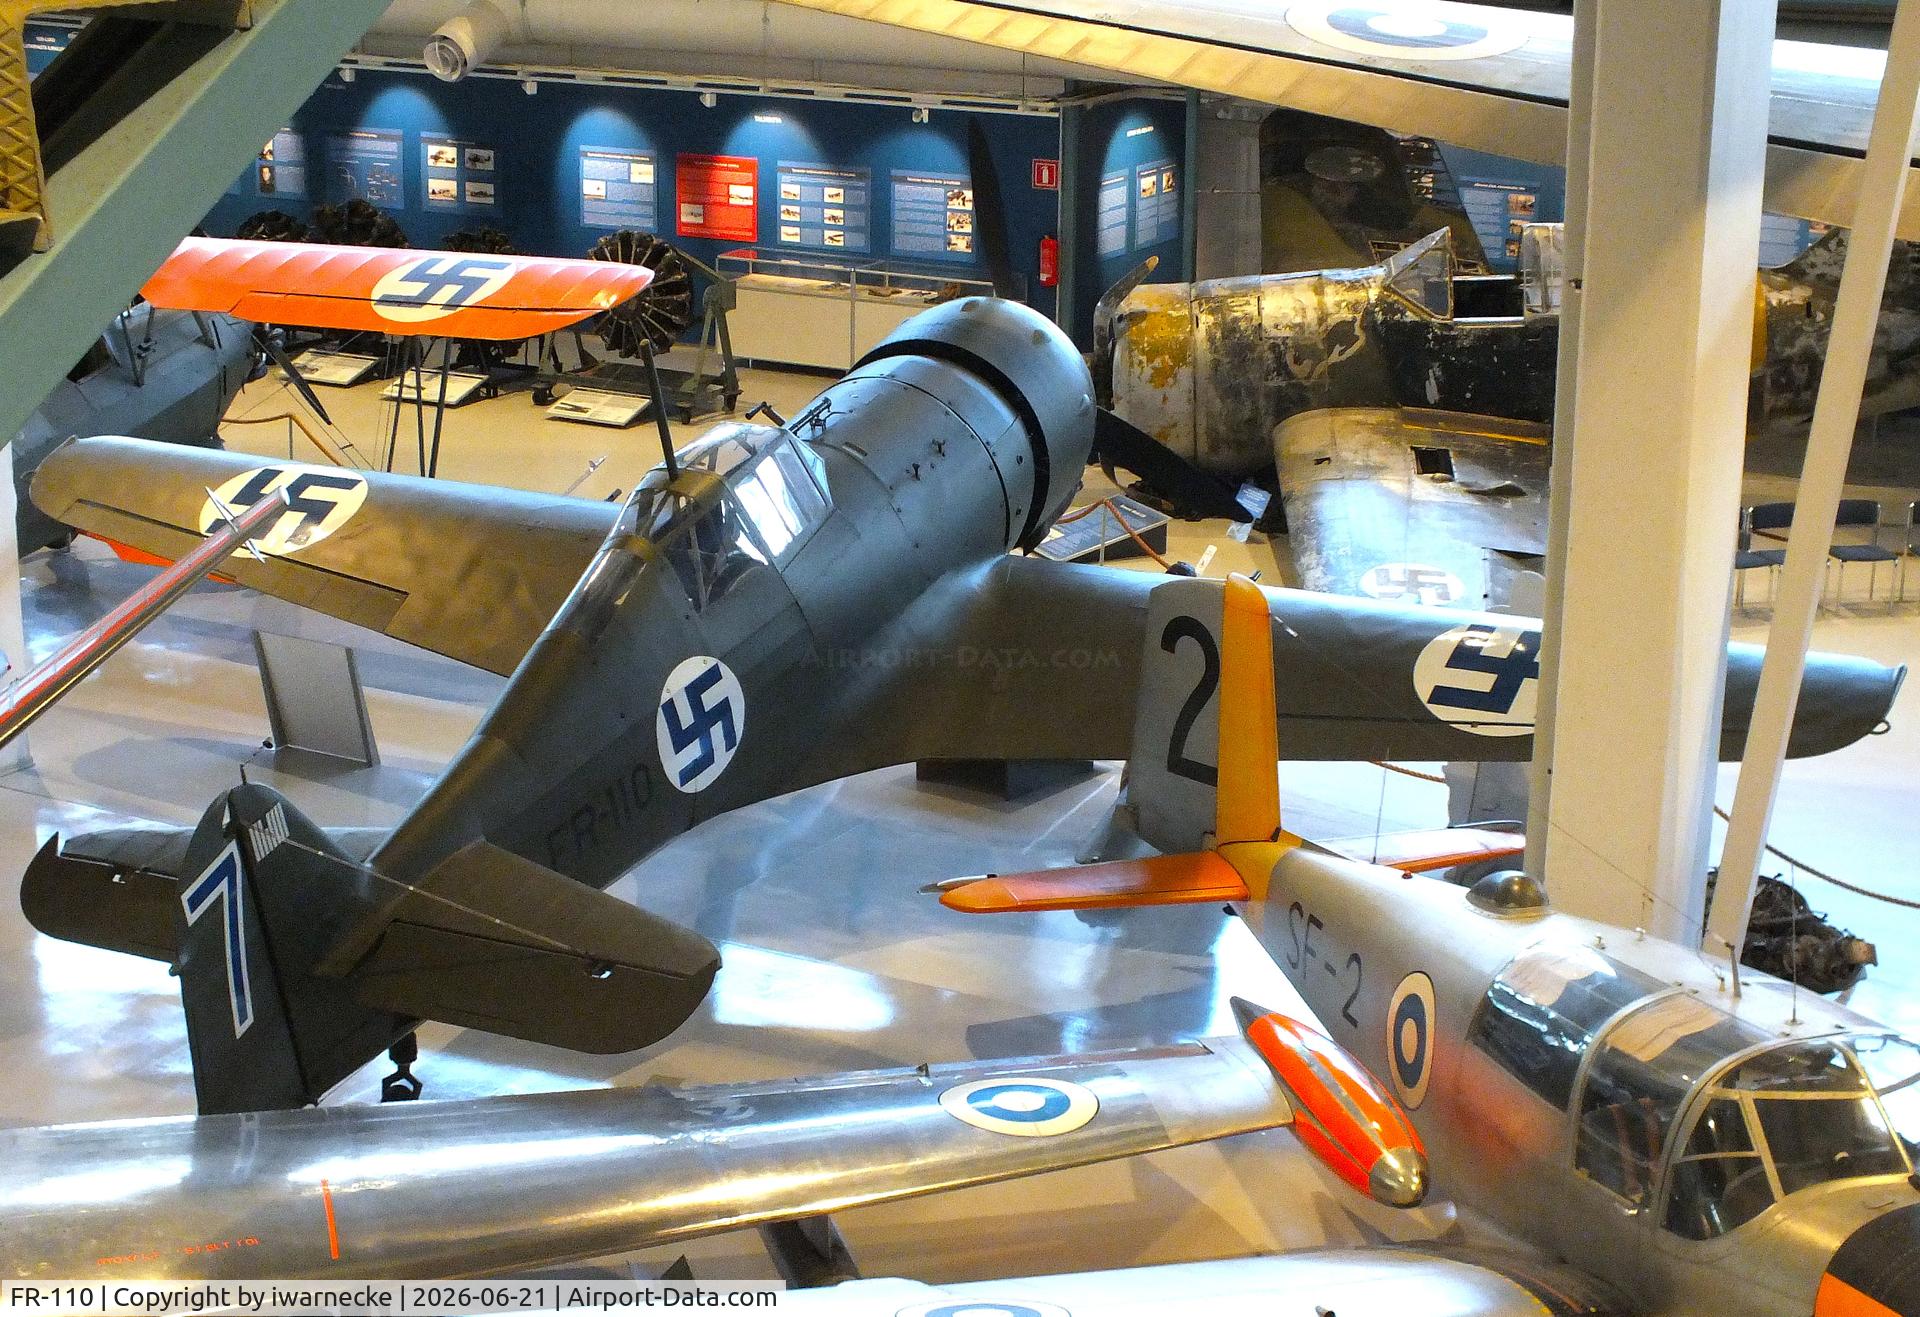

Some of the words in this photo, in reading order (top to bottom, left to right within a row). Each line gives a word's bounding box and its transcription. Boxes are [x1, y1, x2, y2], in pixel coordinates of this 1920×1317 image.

[1160, 615, 1220, 787] 2
[546, 762, 653, 870] FR-110
[180, 838, 254, 1040] 7
[1286, 901, 1362, 1028] SF-2
